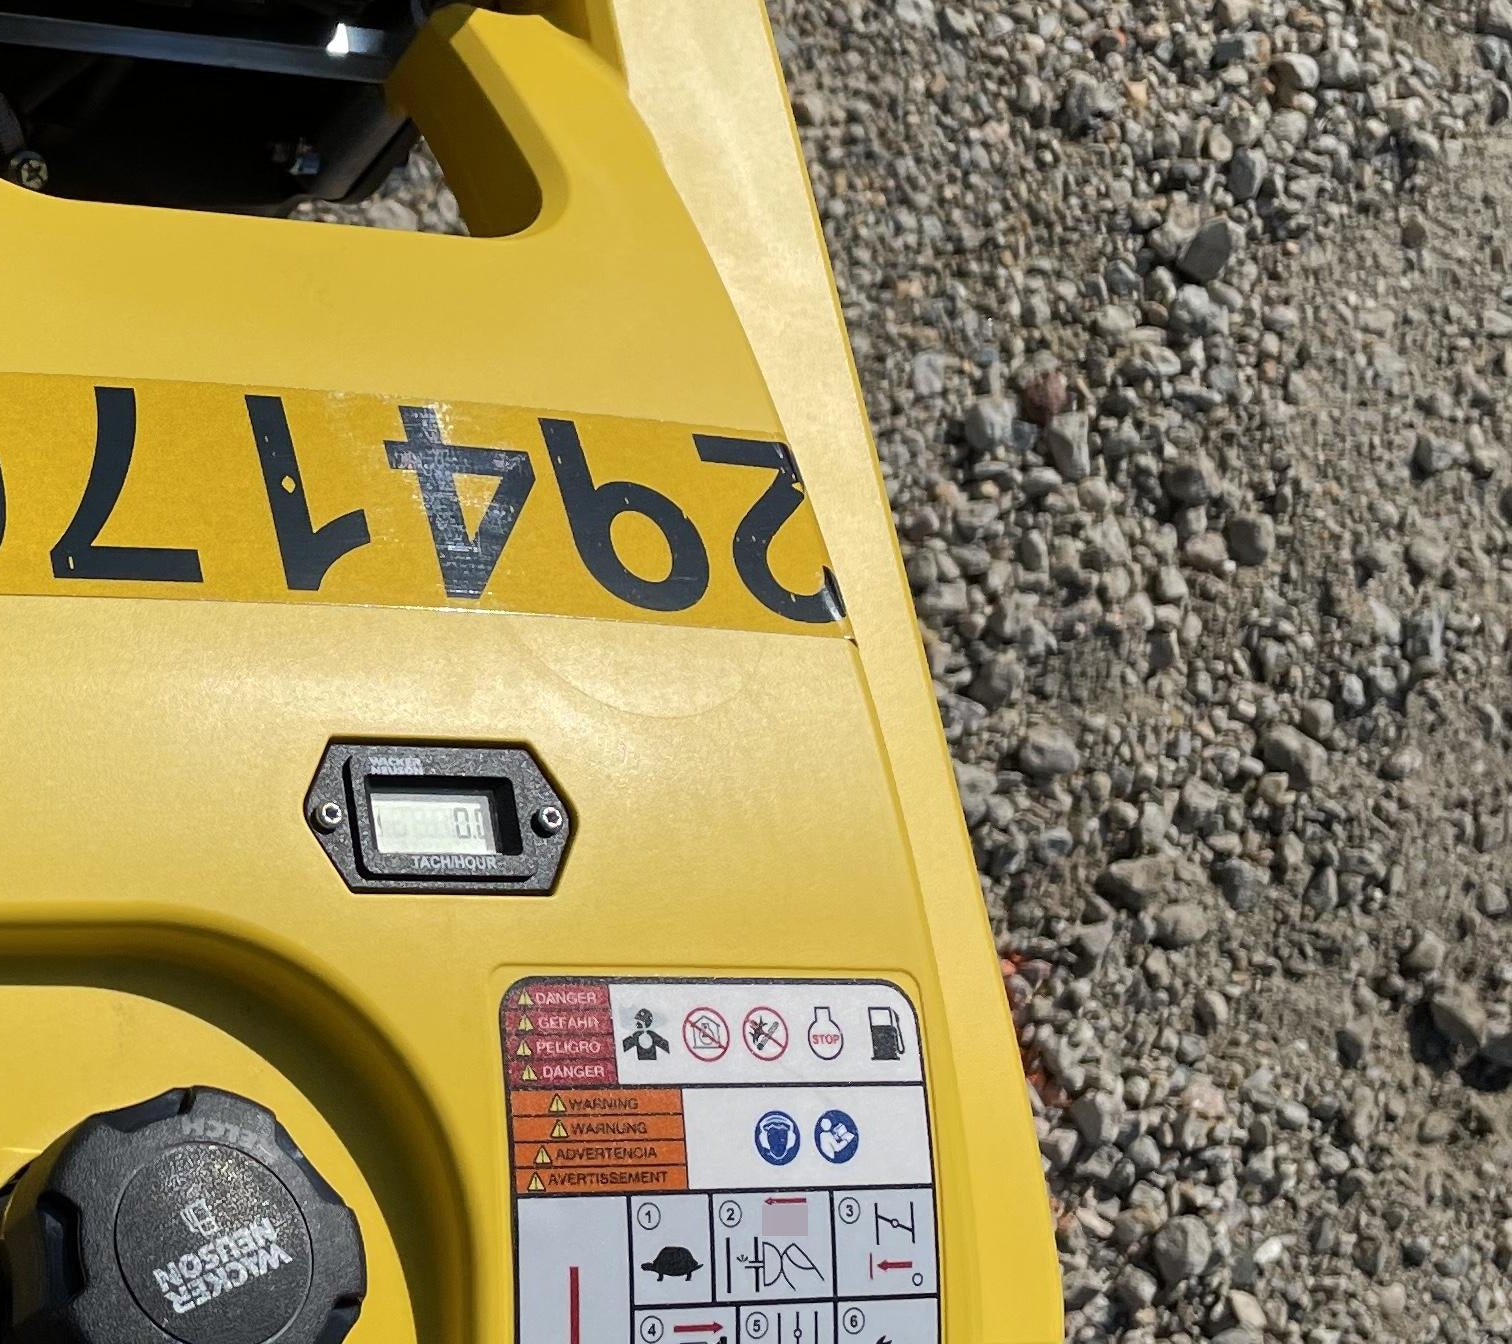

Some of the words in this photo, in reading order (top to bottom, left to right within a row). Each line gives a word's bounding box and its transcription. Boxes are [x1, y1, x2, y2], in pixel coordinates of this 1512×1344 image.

[412, 856, 498, 870] TACH/HOUR
[535, 991, 597, 1006] DANGER
[538, 1016, 601, 1031] GEFAHR
[536, 1040, 601, 1055] PELIGRO
[812, 1034, 840, 1045] STOP
[542, 1065, 605, 1080] DANGER
[569, 1097, 639, 1111] WARNING
[571, 1121, 647, 1136] WARNUNG
[555, 1146, 657, 1162] ADVERTENCIA
[548, 1171, 668, 1187] AVERTISSEMENT
[644, 1207, 654, 1226] 1
[725, 1206, 736, 1225] 2
[845, 1202, 856, 1222] 3
[152, 1216, 282, 1293] NEUSON
[163, 1244, 294, 1315] WACKER
[751, 1316, 762, 1335] 5
[849, 1312, 859, 1330] 6
[647, 1320, 658, 1339] 4
